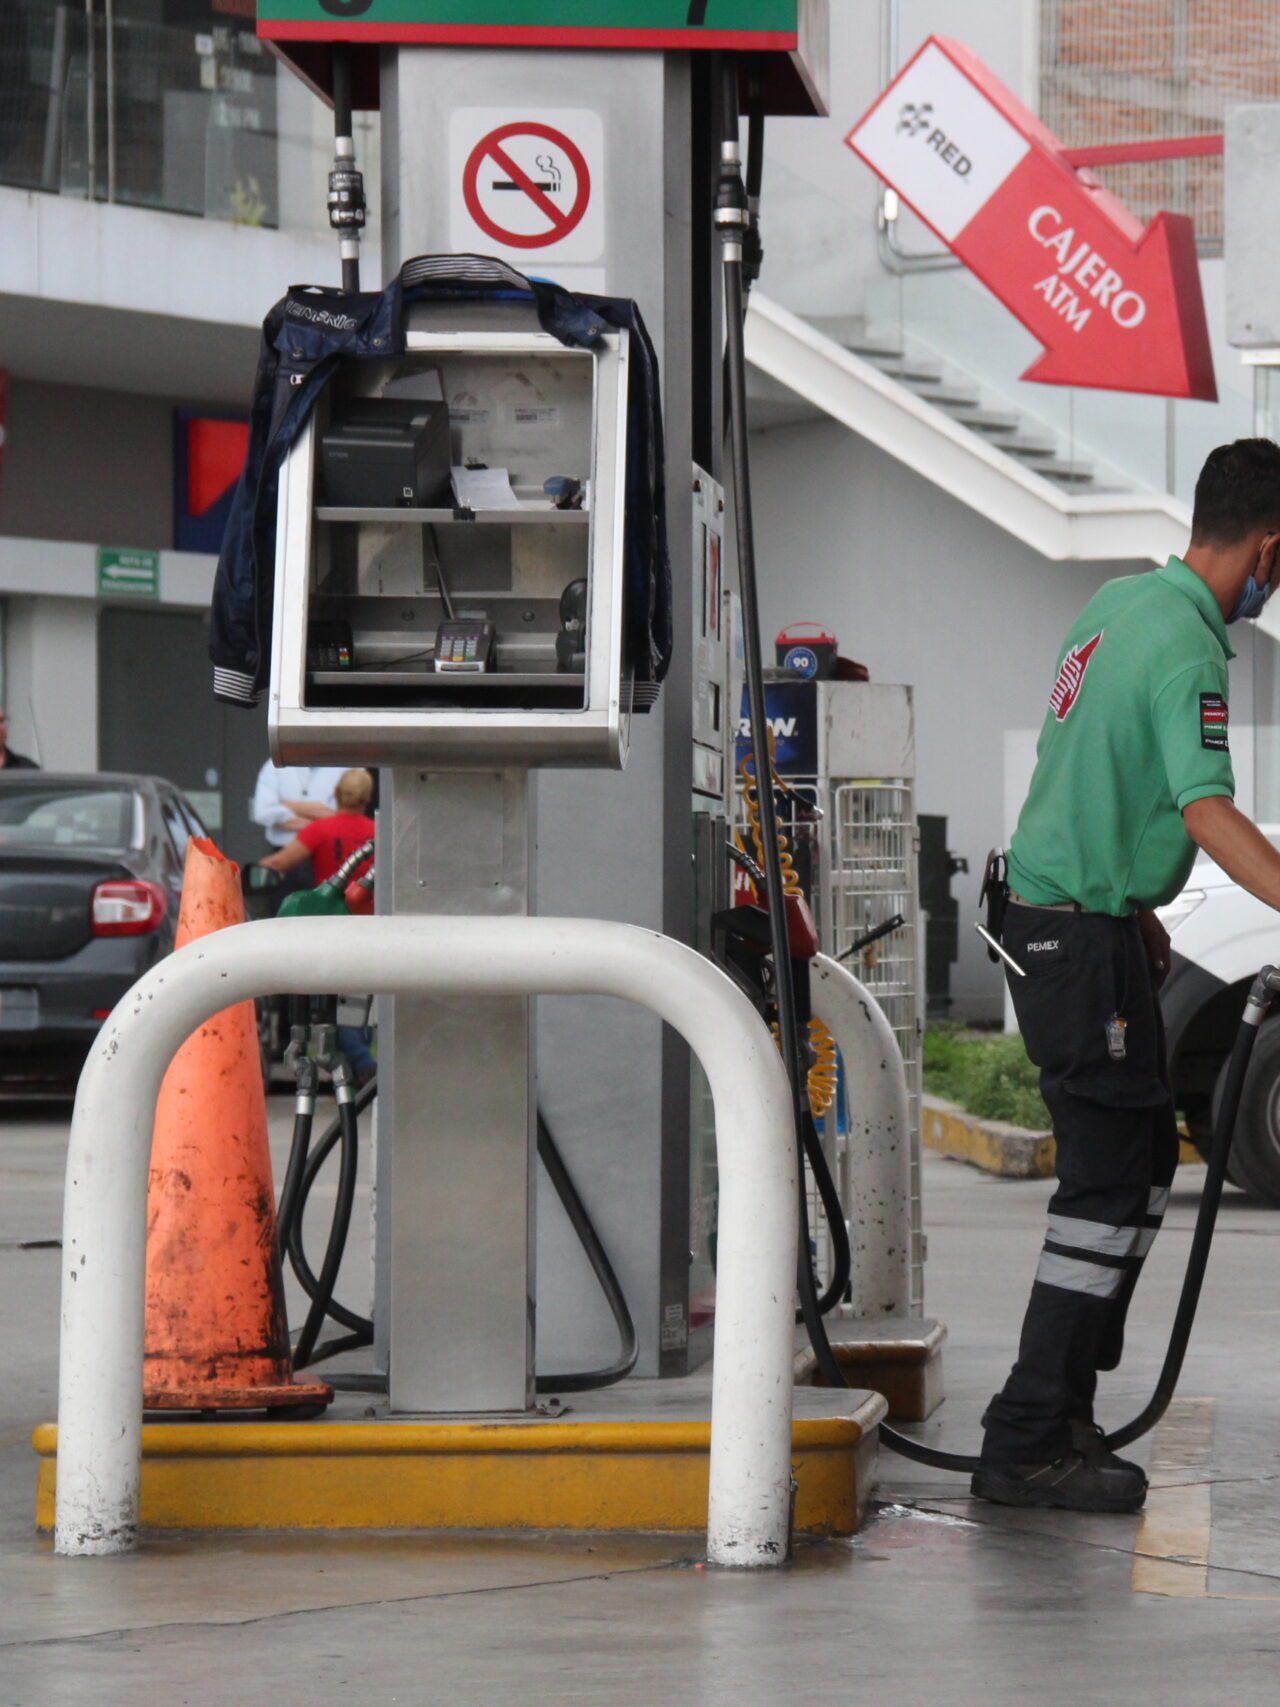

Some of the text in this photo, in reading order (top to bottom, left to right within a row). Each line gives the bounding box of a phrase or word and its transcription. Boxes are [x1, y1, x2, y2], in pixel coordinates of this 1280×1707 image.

[926, 128, 972, 178] RED
[1028, 205, 1146, 329] CAJERO
[1033, 274, 1092, 333] ATM
[792, 656, 809, 668] 90
[1027, 940, 1059, 952] PEMEX
